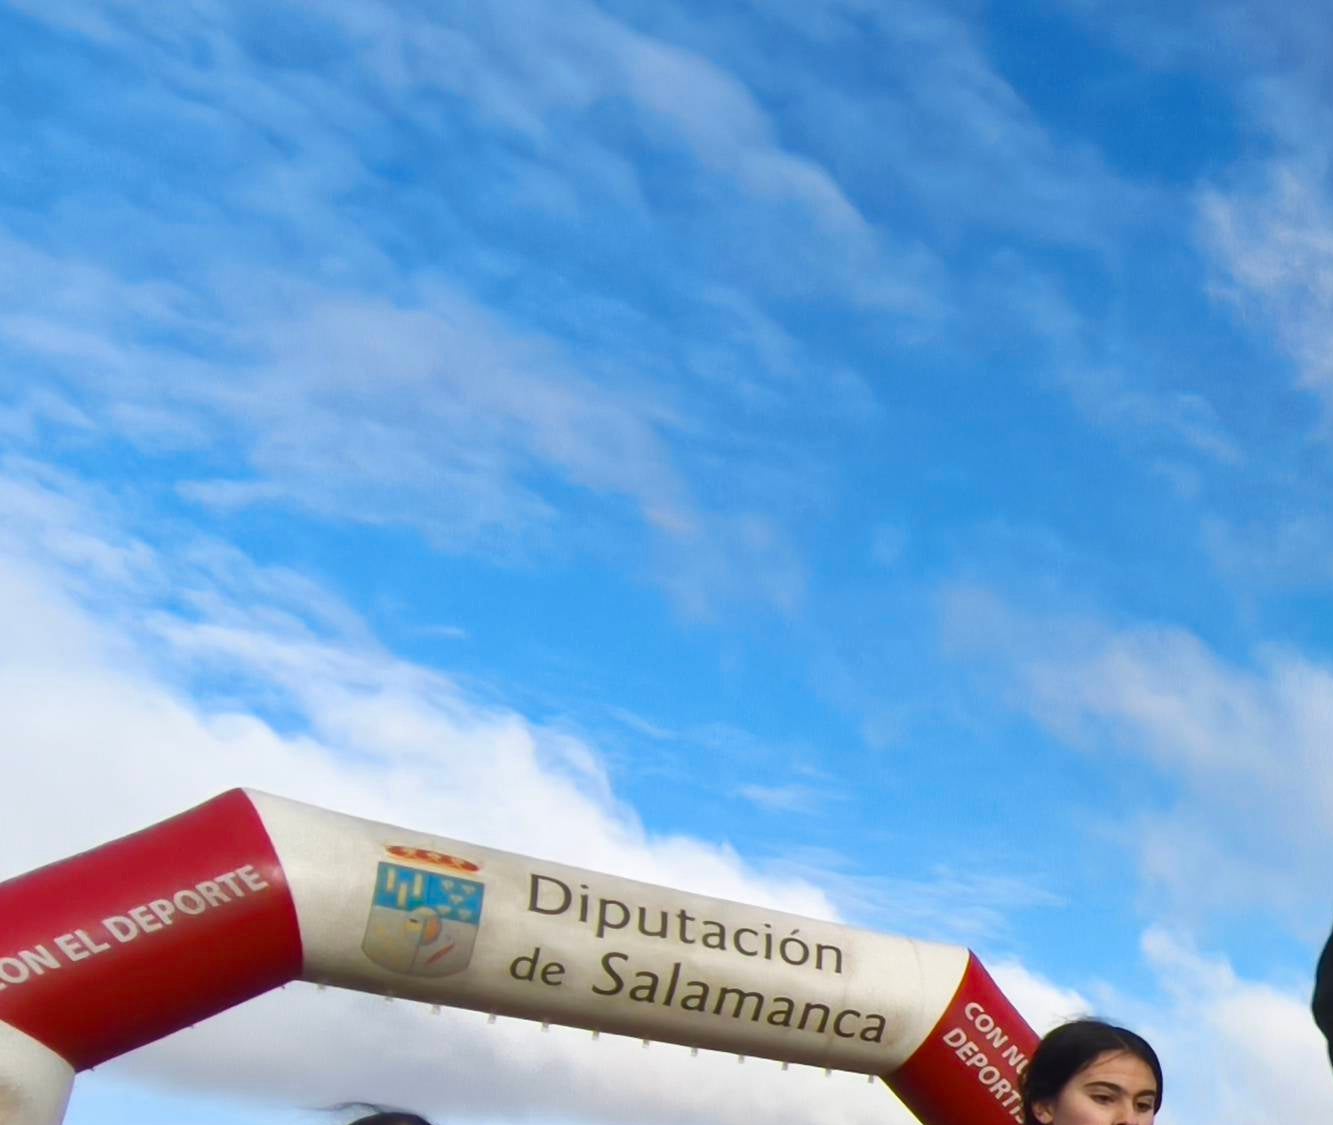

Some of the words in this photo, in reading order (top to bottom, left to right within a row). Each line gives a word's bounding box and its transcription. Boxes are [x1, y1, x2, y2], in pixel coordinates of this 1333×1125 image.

[53, 928, 111, 962] EL
[102, 864, 269, 944] DEPORTE
[527, 872, 844, 974] Diputación
[508, 946, 566, 987] de
[590, 951, 888, 1044] Salamanca
[963, 1001, 1009, 1050] CON
